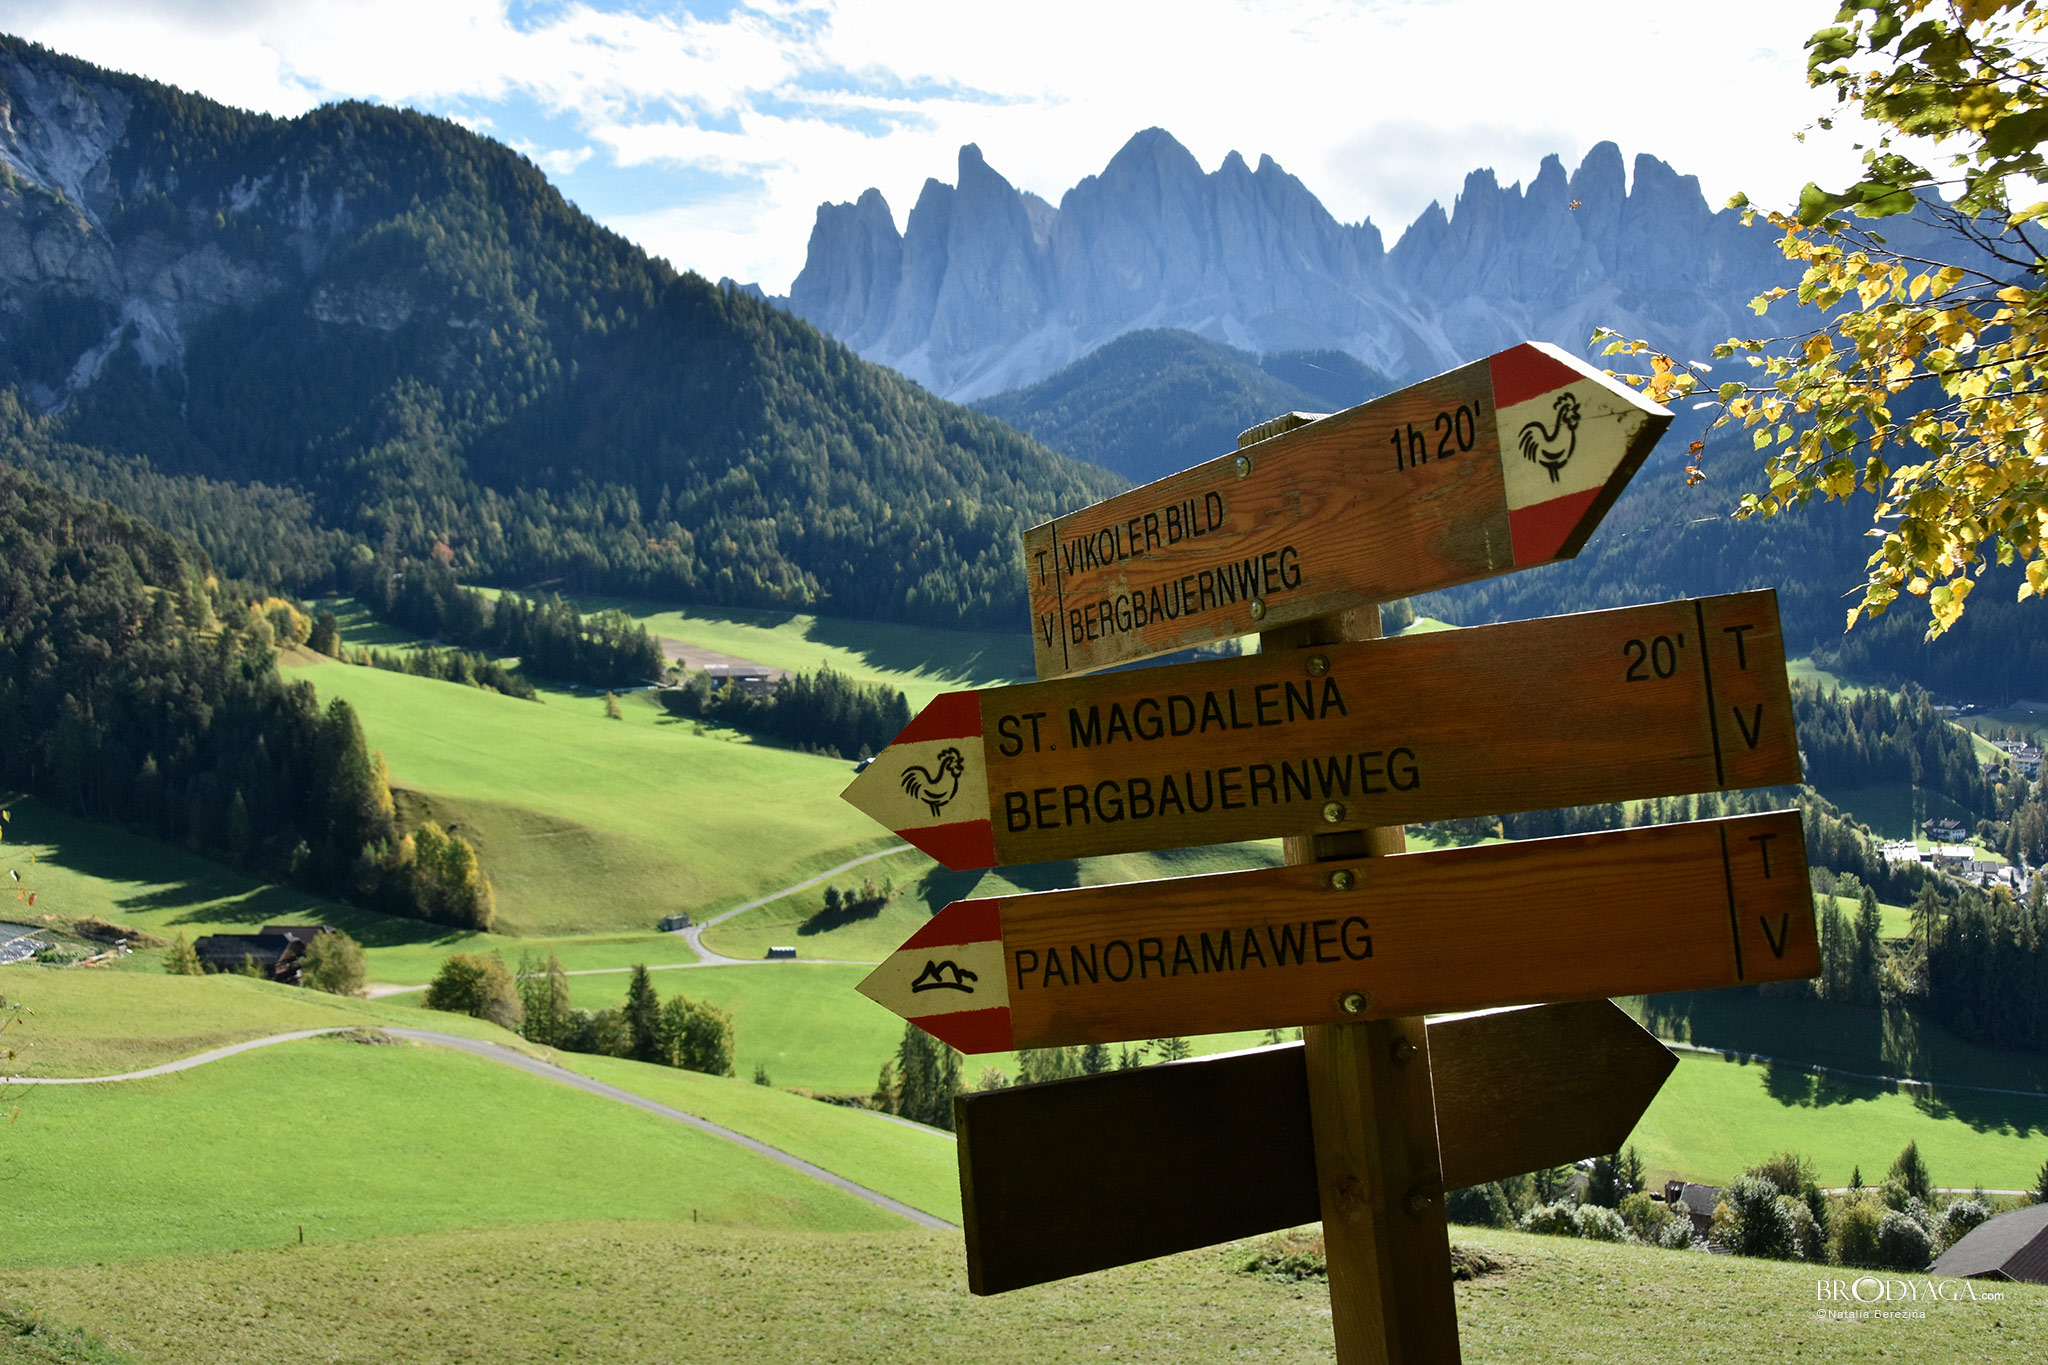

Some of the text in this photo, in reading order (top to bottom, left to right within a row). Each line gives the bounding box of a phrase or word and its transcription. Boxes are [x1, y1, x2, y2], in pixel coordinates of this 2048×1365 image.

[1390, 399, 1480, 471] 1h 20'
[1034, 550, 1048, 587] T
[1069, 545, 1302, 645] BERGBAUERNWEG
[1040, 612, 1055, 649] V
[1722, 623, 1755, 671] T
[1623, 632, 1686, 683] 20'
[998, 676, 1348, 758] ST. MAGDALENA
[1732, 702, 1764, 751] V
[1005, 746, 1421, 834] BERGBAUERNWEG
[1747, 833, 1778, 880] T
[1014, 915, 1375, 991] PANORAMAWEG
[1759, 912, 1789, 960] V
